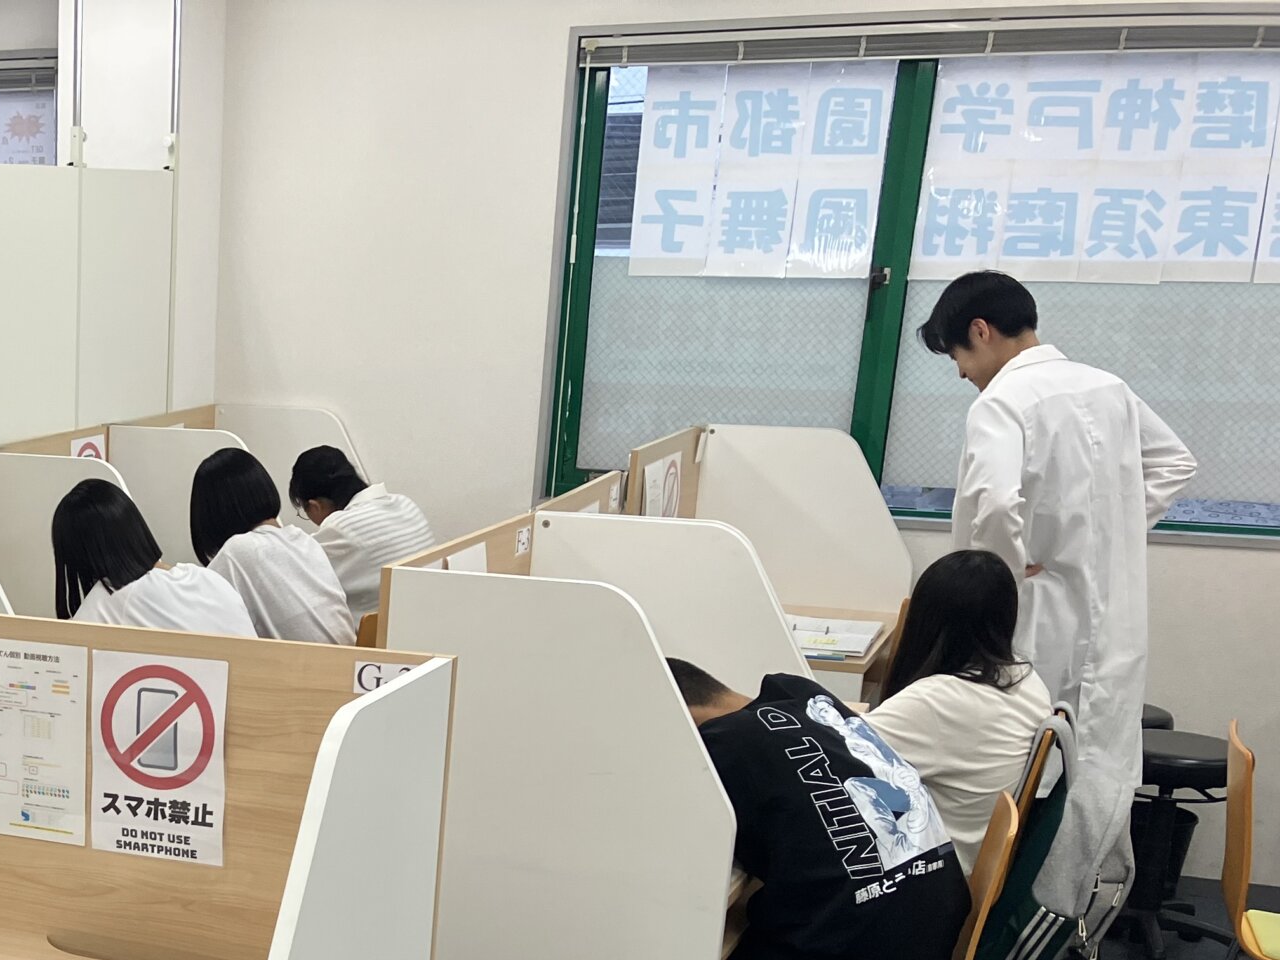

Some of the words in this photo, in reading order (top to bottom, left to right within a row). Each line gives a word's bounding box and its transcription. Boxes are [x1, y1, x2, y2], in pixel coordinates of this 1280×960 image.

[101, 792, 214, 828] スマホ禁止
[784, 736, 885, 880] INITIAL
[115, 839, 198, 860] SMARTPHONE
[121, 827, 138, 838] DO
[140, 830, 165, 842] NOT
[167, 834, 191, 846] USE
